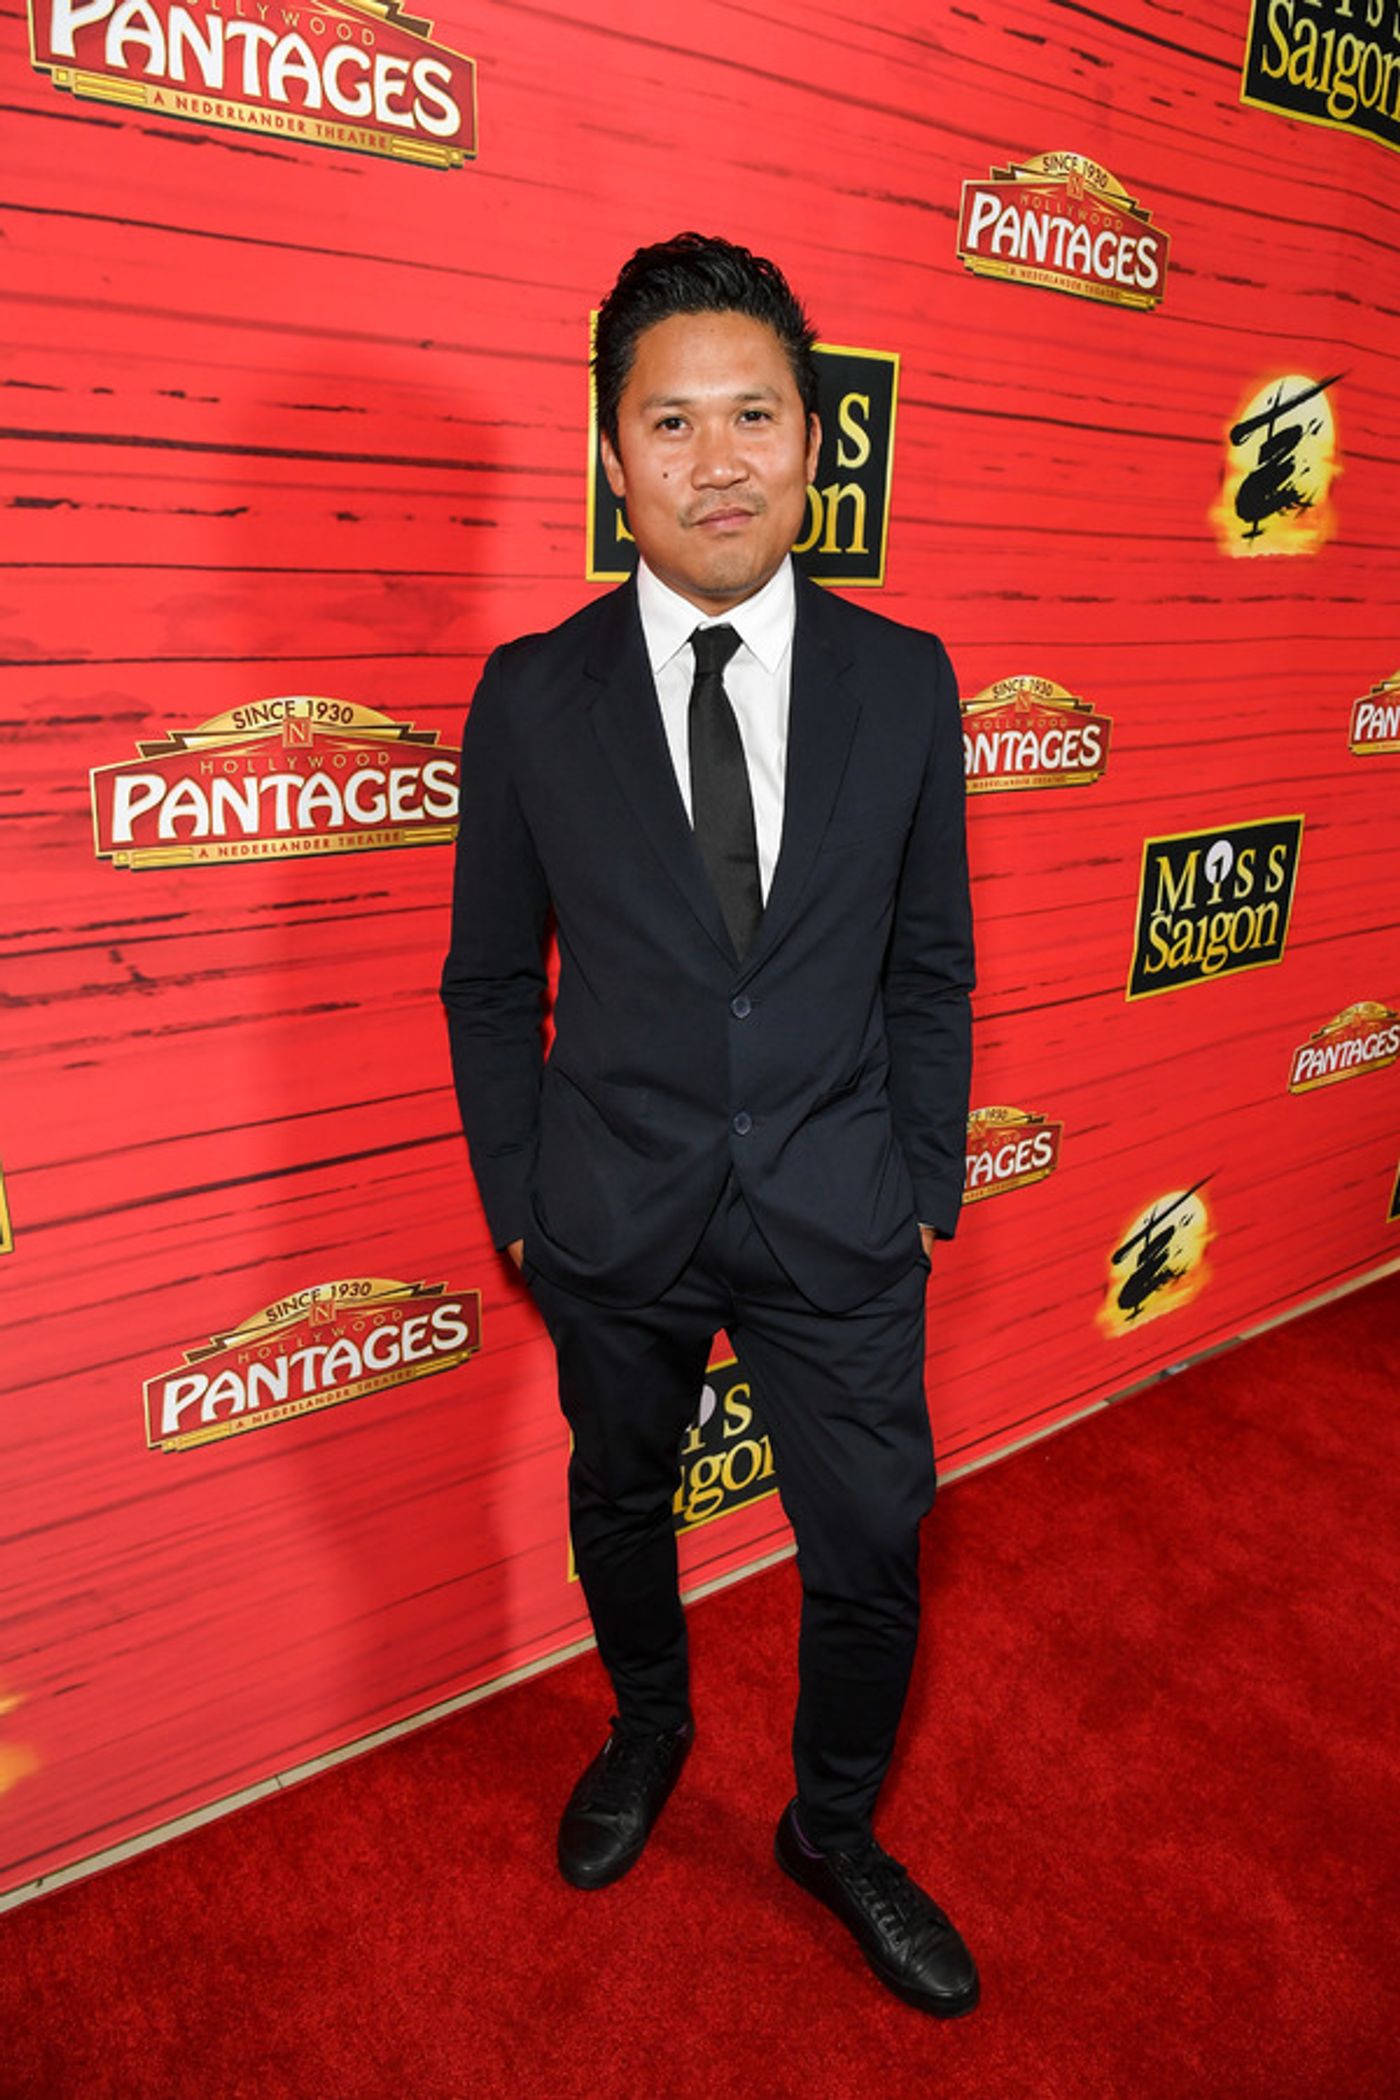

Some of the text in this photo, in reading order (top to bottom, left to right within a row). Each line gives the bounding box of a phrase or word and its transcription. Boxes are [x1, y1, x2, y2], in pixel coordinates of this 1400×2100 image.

[187, 0, 375, 46] LLYWOOD
[51, 0, 461, 137] PANTAGES
[153, 91, 389, 149] A NEDERLANDER THEATRE
[1042, 154, 1109, 188] SINCE 1930
[966, 191, 1158, 289] PANTAGES
[231, 700, 354, 730] SINCE 1930
[288, 722, 306, 744] N
[199, 752, 390, 775] HOLLYWOOD
[963, 725, 1101, 775] ANTAGES
[111, 760, 460, 843] PANTAGES
[198, 848, 209, 859] A
[217, 837, 331, 858] NEDERLANDER
[1143, 900, 1280, 975] Saigon
[1292, 1024, 1400, 1084] PANTAGES
[265, 1281, 372, 1323] SINCE 1930
[238, 1309, 403, 1364] HOLLYWOOD
[160, 1303, 469, 1434] PANTAGES
